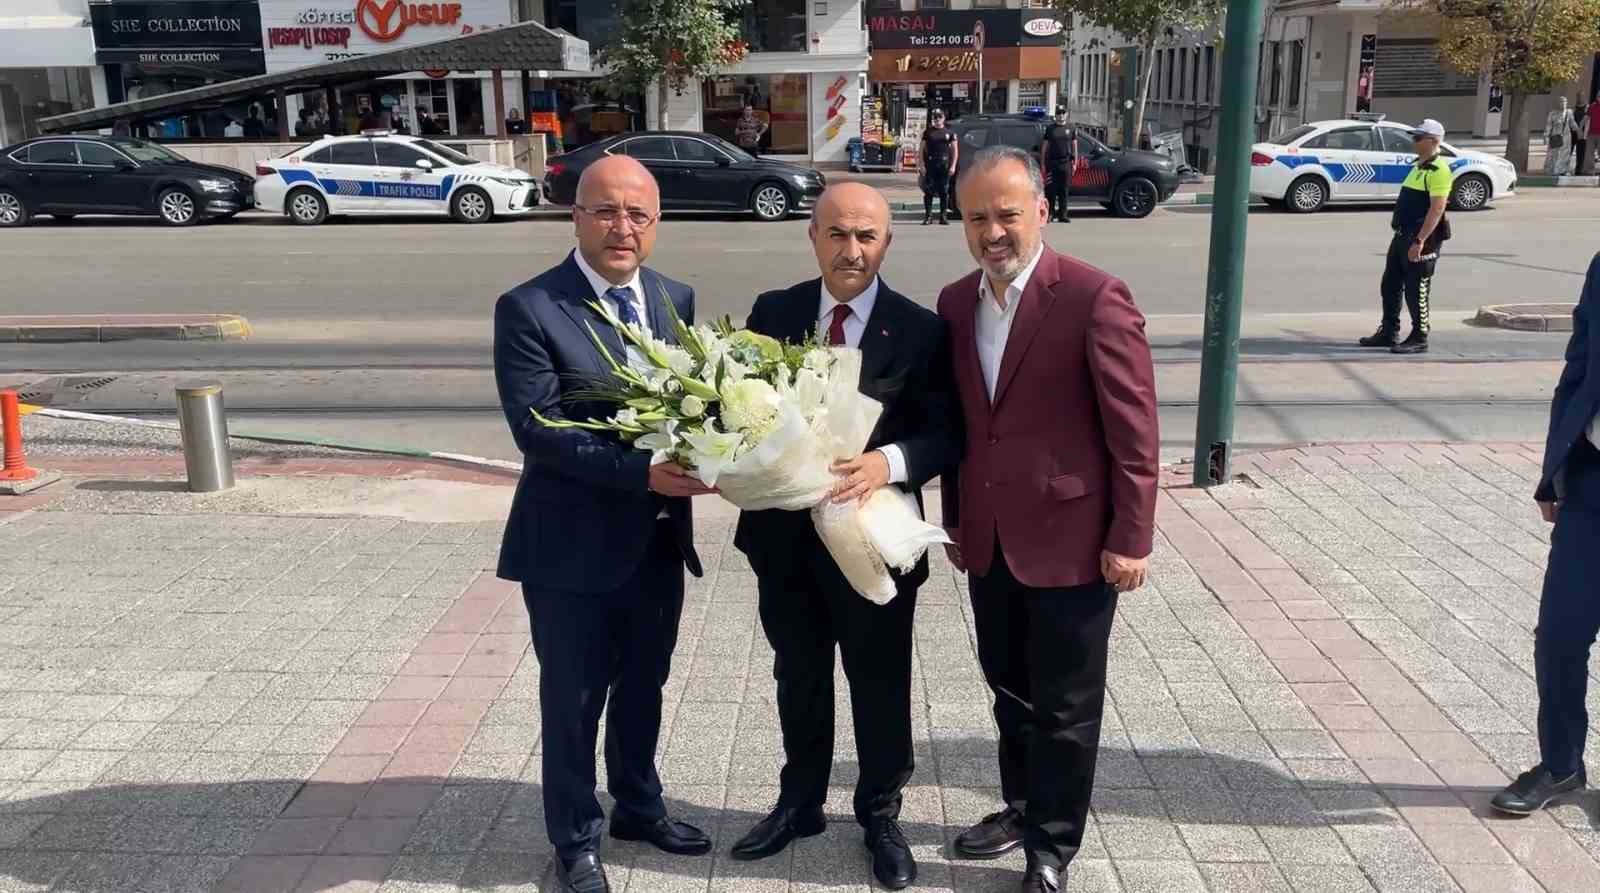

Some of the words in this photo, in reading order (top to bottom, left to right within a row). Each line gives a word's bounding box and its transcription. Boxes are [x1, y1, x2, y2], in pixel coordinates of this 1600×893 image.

[111, 19, 141, 33] SHE
[357, 0, 462, 43] YUSUF
[871, 16, 936, 31] MASAJ
[1030, 20, 1057, 33] DEVA
[910, 36, 928, 45] Tel:
[929, 35, 946, 45] 221
[948, 35, 961, 44] 00
[139, 53, 159, 62] SHE
